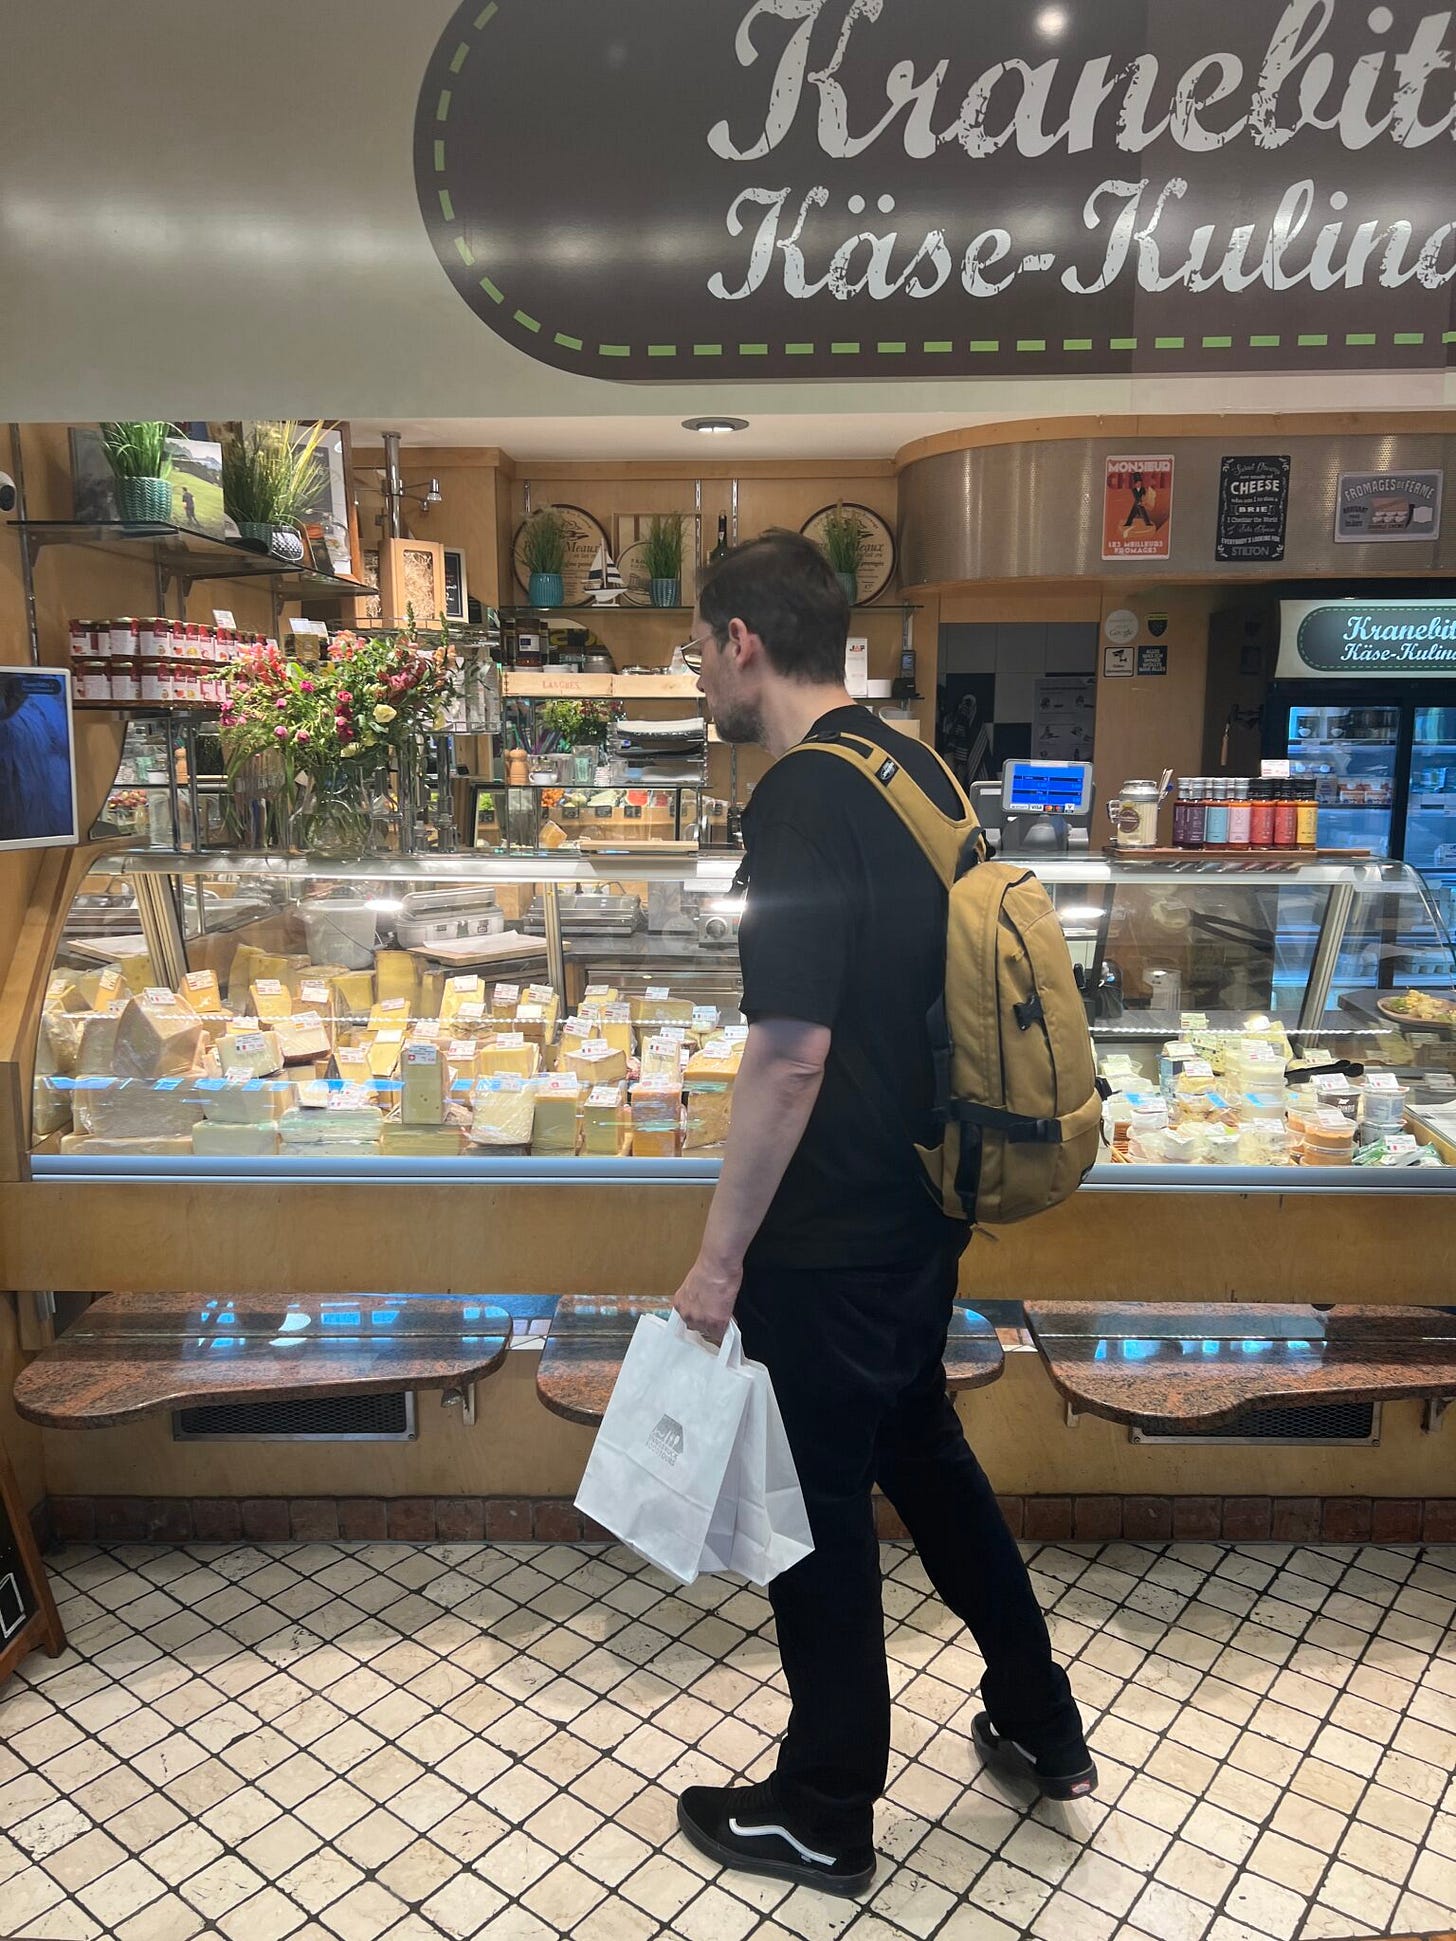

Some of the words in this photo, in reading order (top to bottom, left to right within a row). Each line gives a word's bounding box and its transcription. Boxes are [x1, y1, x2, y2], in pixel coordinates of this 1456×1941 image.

[707, 0, 1456, 160] Kranebit
[1108, 461, 1170, 473] MONSIEUR
[1230, 479, 1280, 495] CHEESE
[1344, 478, 1397, 502] FROMAGES
[1404, 479, 1435, 499] FERME
[1231, 546, 1270, 556] STILTON
